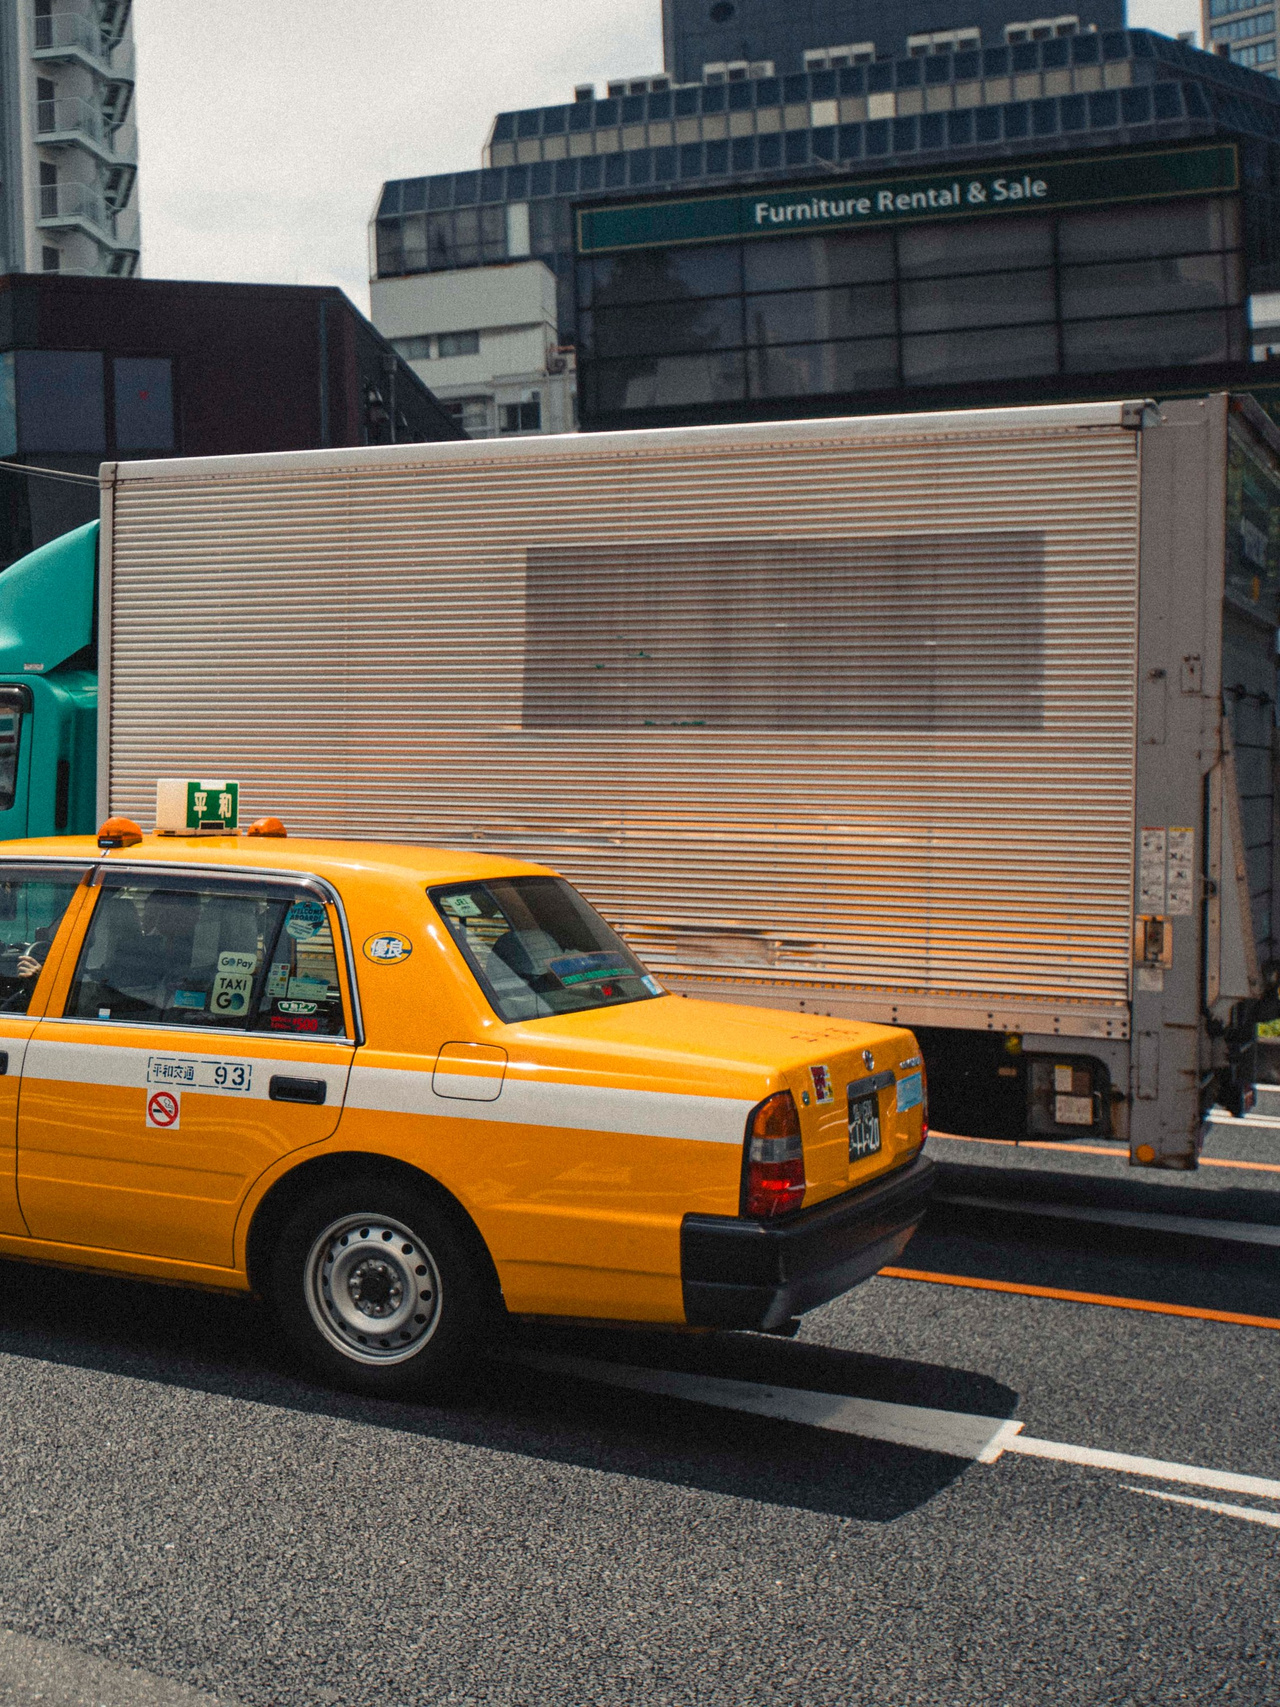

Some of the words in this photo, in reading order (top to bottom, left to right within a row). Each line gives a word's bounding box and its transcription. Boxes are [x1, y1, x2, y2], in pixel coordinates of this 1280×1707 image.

[755, 197, 870, 225] Furniture
[877, 183, 961, 213] Rental
[967, 181, 988, 203] &
[993, 176, 1048, 201] Sale
[192, 791, 233, 819] 平和
[290, 907, 324, 916] WELCOME
[290, 914, 321, 922] ABOARD!
[370, 939, 403, 958] 優良
[237, 958, 254, 970] Pay
[220, 977, 247, 991] TAXI
[216, 991, 245, 1011] GO
[152, 1063, 195, 1081] 平和交通
[214, 1066, 246, 1086] 93
